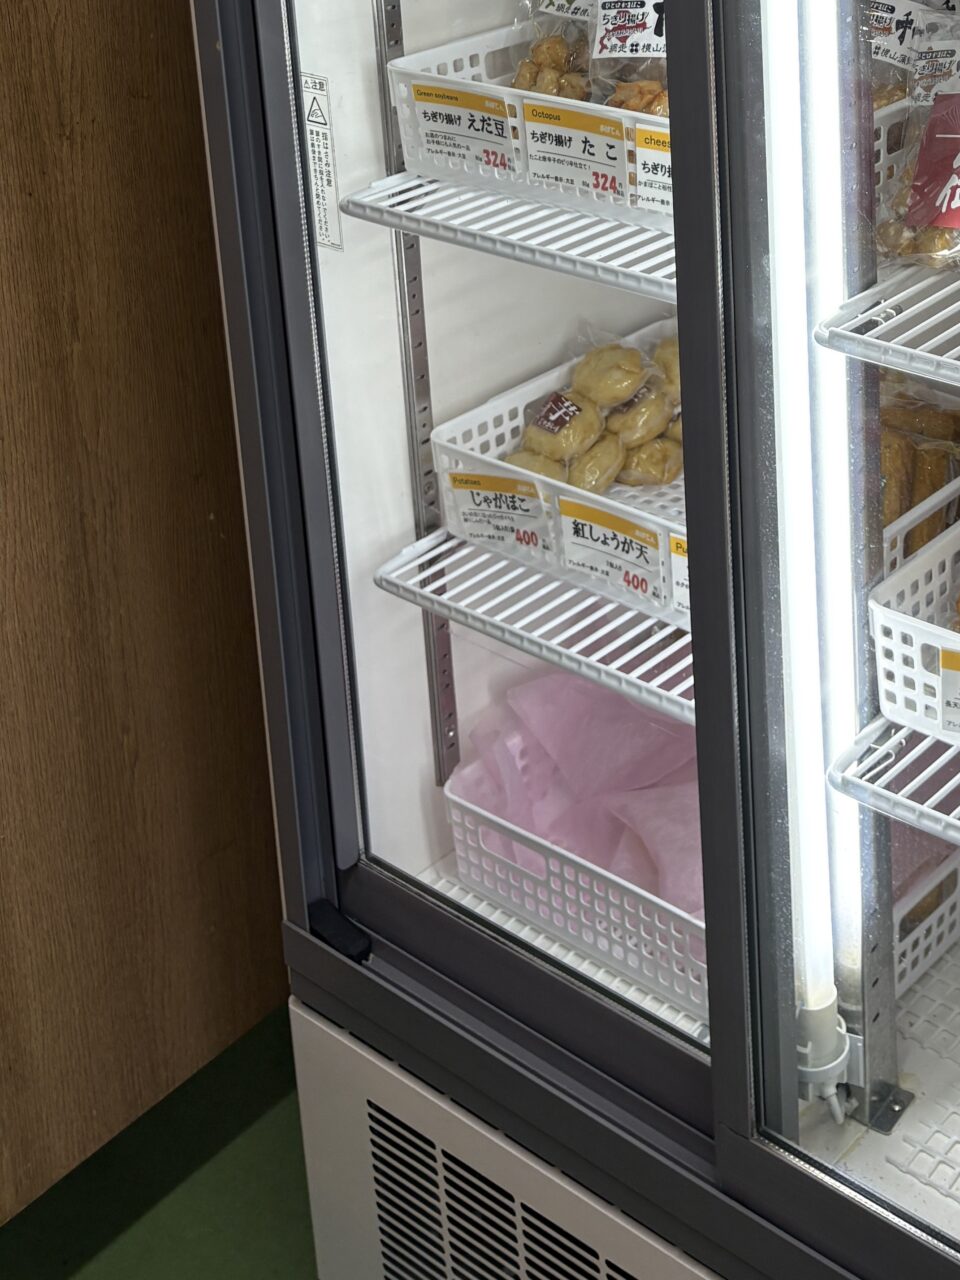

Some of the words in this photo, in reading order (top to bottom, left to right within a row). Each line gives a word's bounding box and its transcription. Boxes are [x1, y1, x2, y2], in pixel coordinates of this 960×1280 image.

[602, 11, 649, 26] ちぎり揚げ
[416, 89, 434, 97] Green
[434, 92, 459, 101] soybeans
[422, 109, 462, 127] ちぎり揚げ
[467, 112, 508, 139] えだ豆
[531, 108, 561, 121] Octopus
[530, 130, 573, 148] ちぎり揚げ
[483, 149, 507, 170] 324
[592, 171, 617, 193] 324
[515, 528, 538, 547] 400
[572, 519, 650, 564] 紅しょうが天
[623, 570, 648, 594] 400
